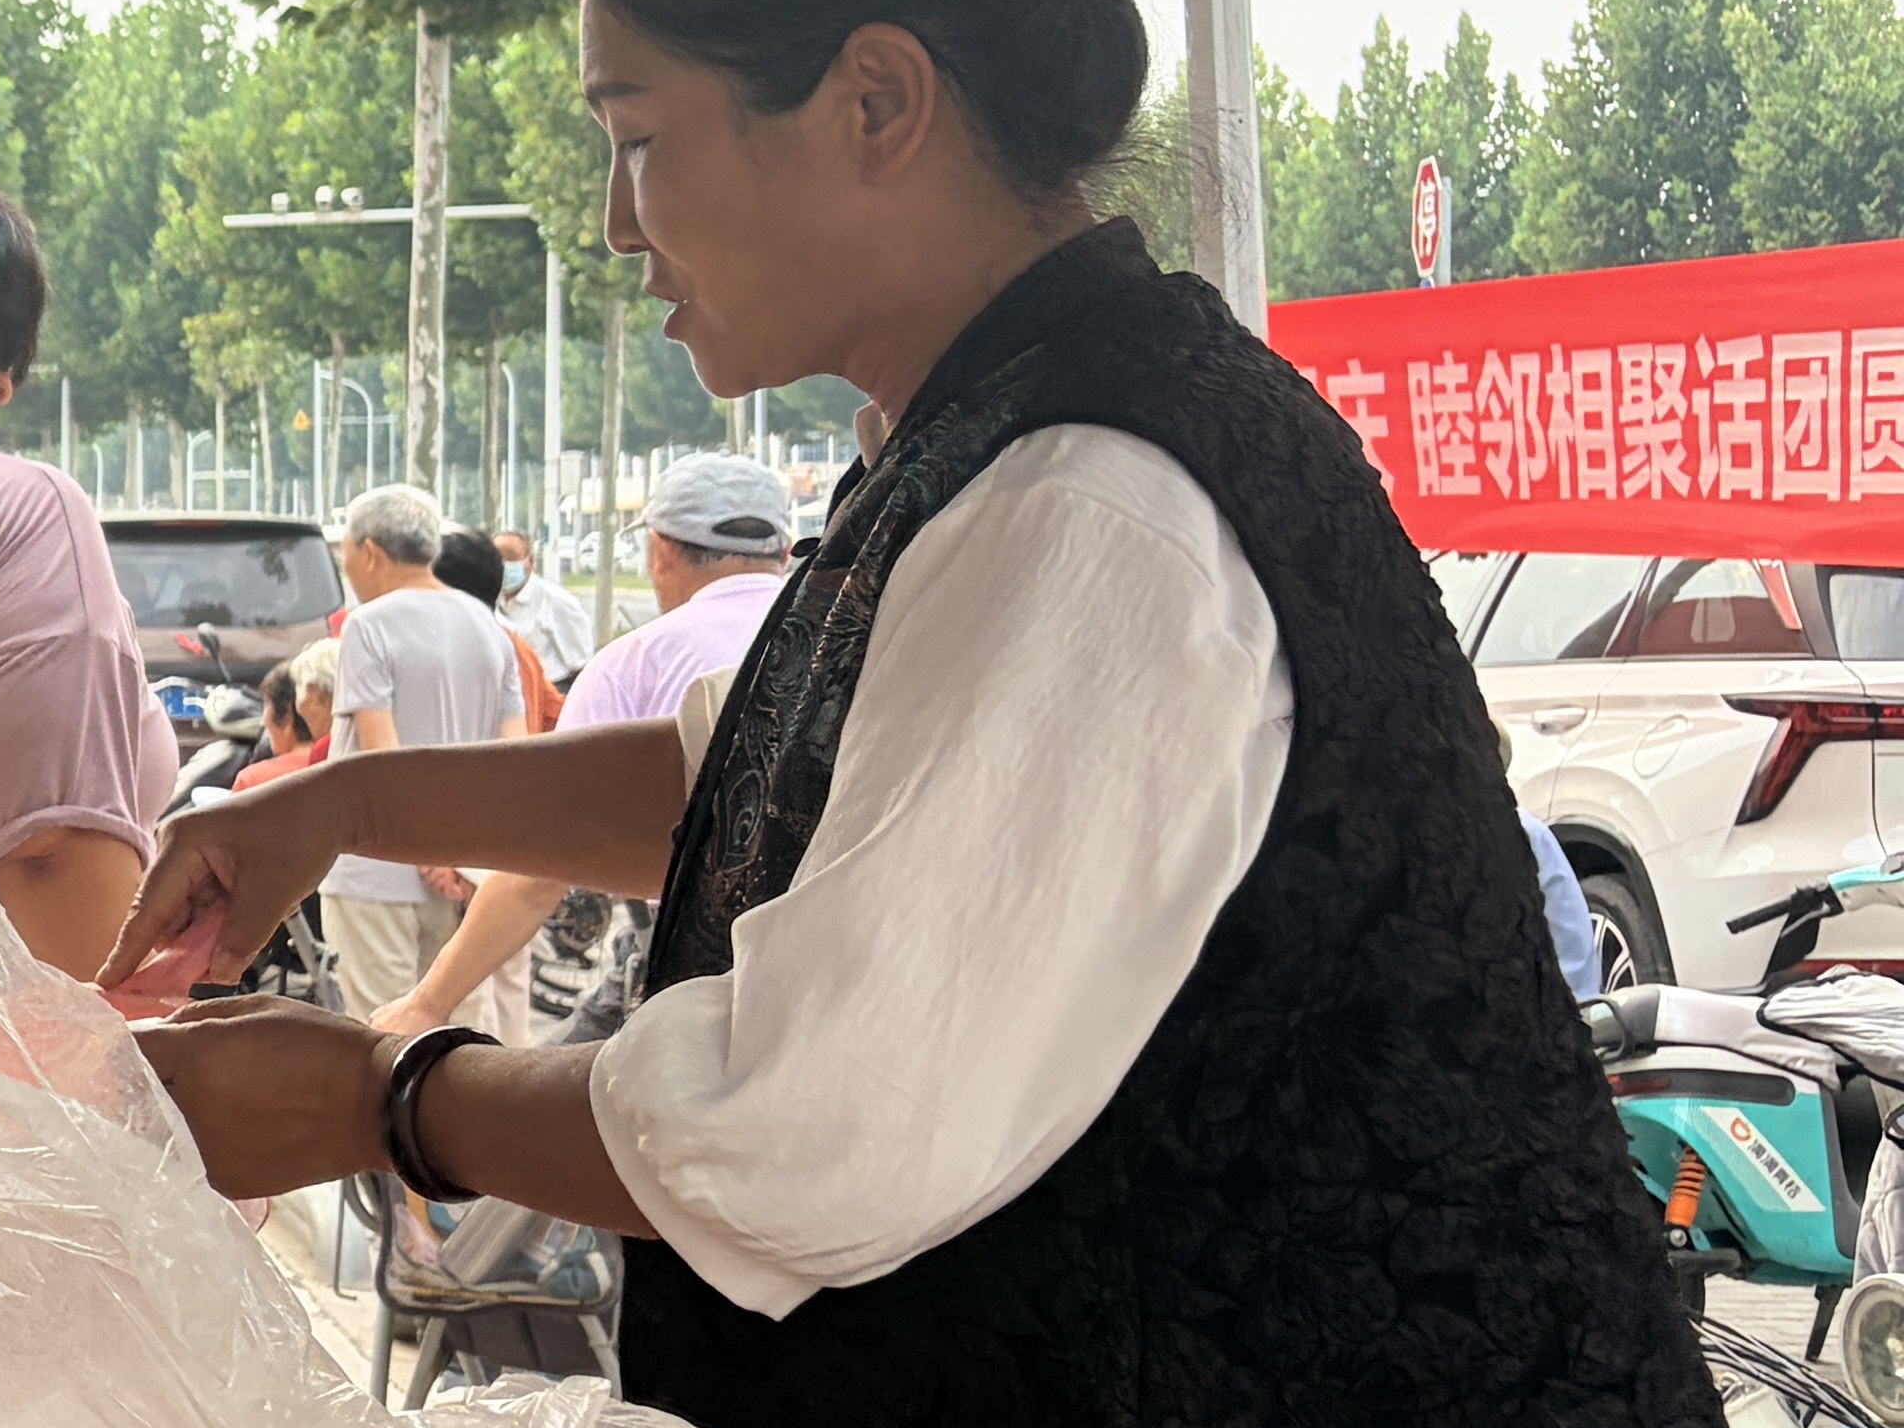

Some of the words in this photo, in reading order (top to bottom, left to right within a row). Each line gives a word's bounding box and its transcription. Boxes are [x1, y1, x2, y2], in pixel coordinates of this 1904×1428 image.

[1417, 177, 1437, 259] 停
[1299, 357, 1395, 498] 庆
[1407, 328, 1904, 502] 睦邻相聚话团圆
